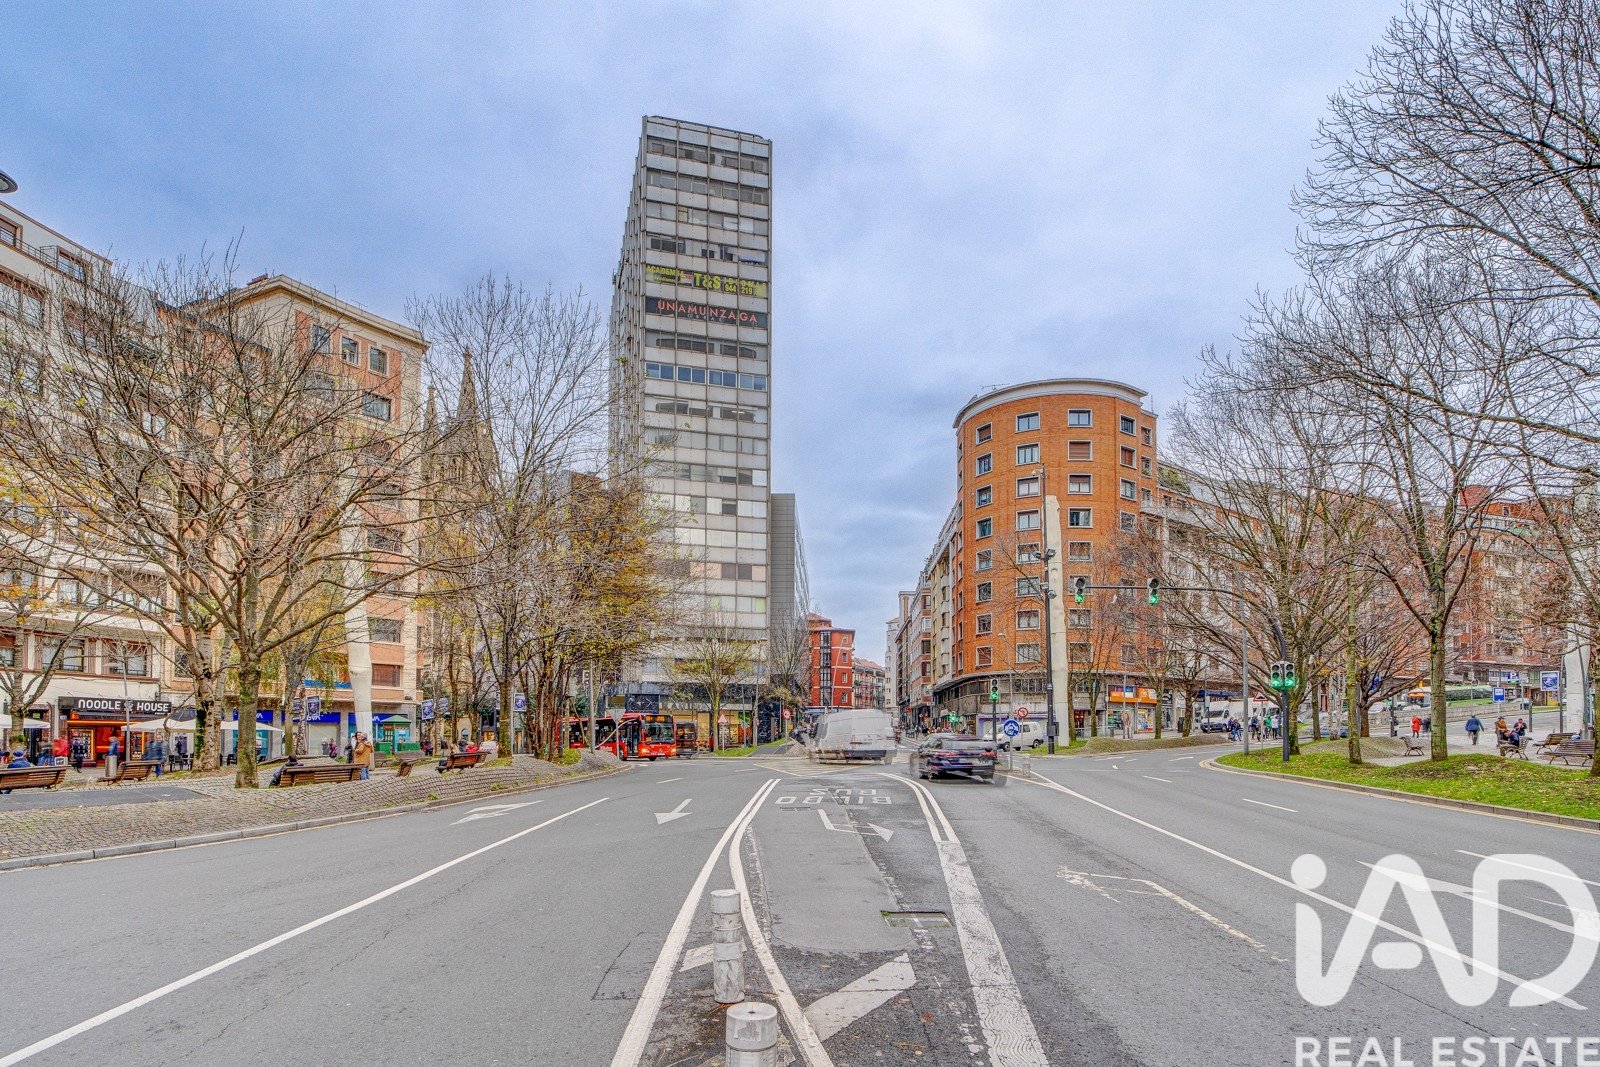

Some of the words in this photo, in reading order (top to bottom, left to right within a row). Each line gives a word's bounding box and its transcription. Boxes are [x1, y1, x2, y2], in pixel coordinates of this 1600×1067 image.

[741, 287, 753, 295] 219
[657, 301, 758, 322] UNAMUNZAGA
[78, 699, 121, 710] NOODLE
[136, 702, 169, 712] HOUSE
